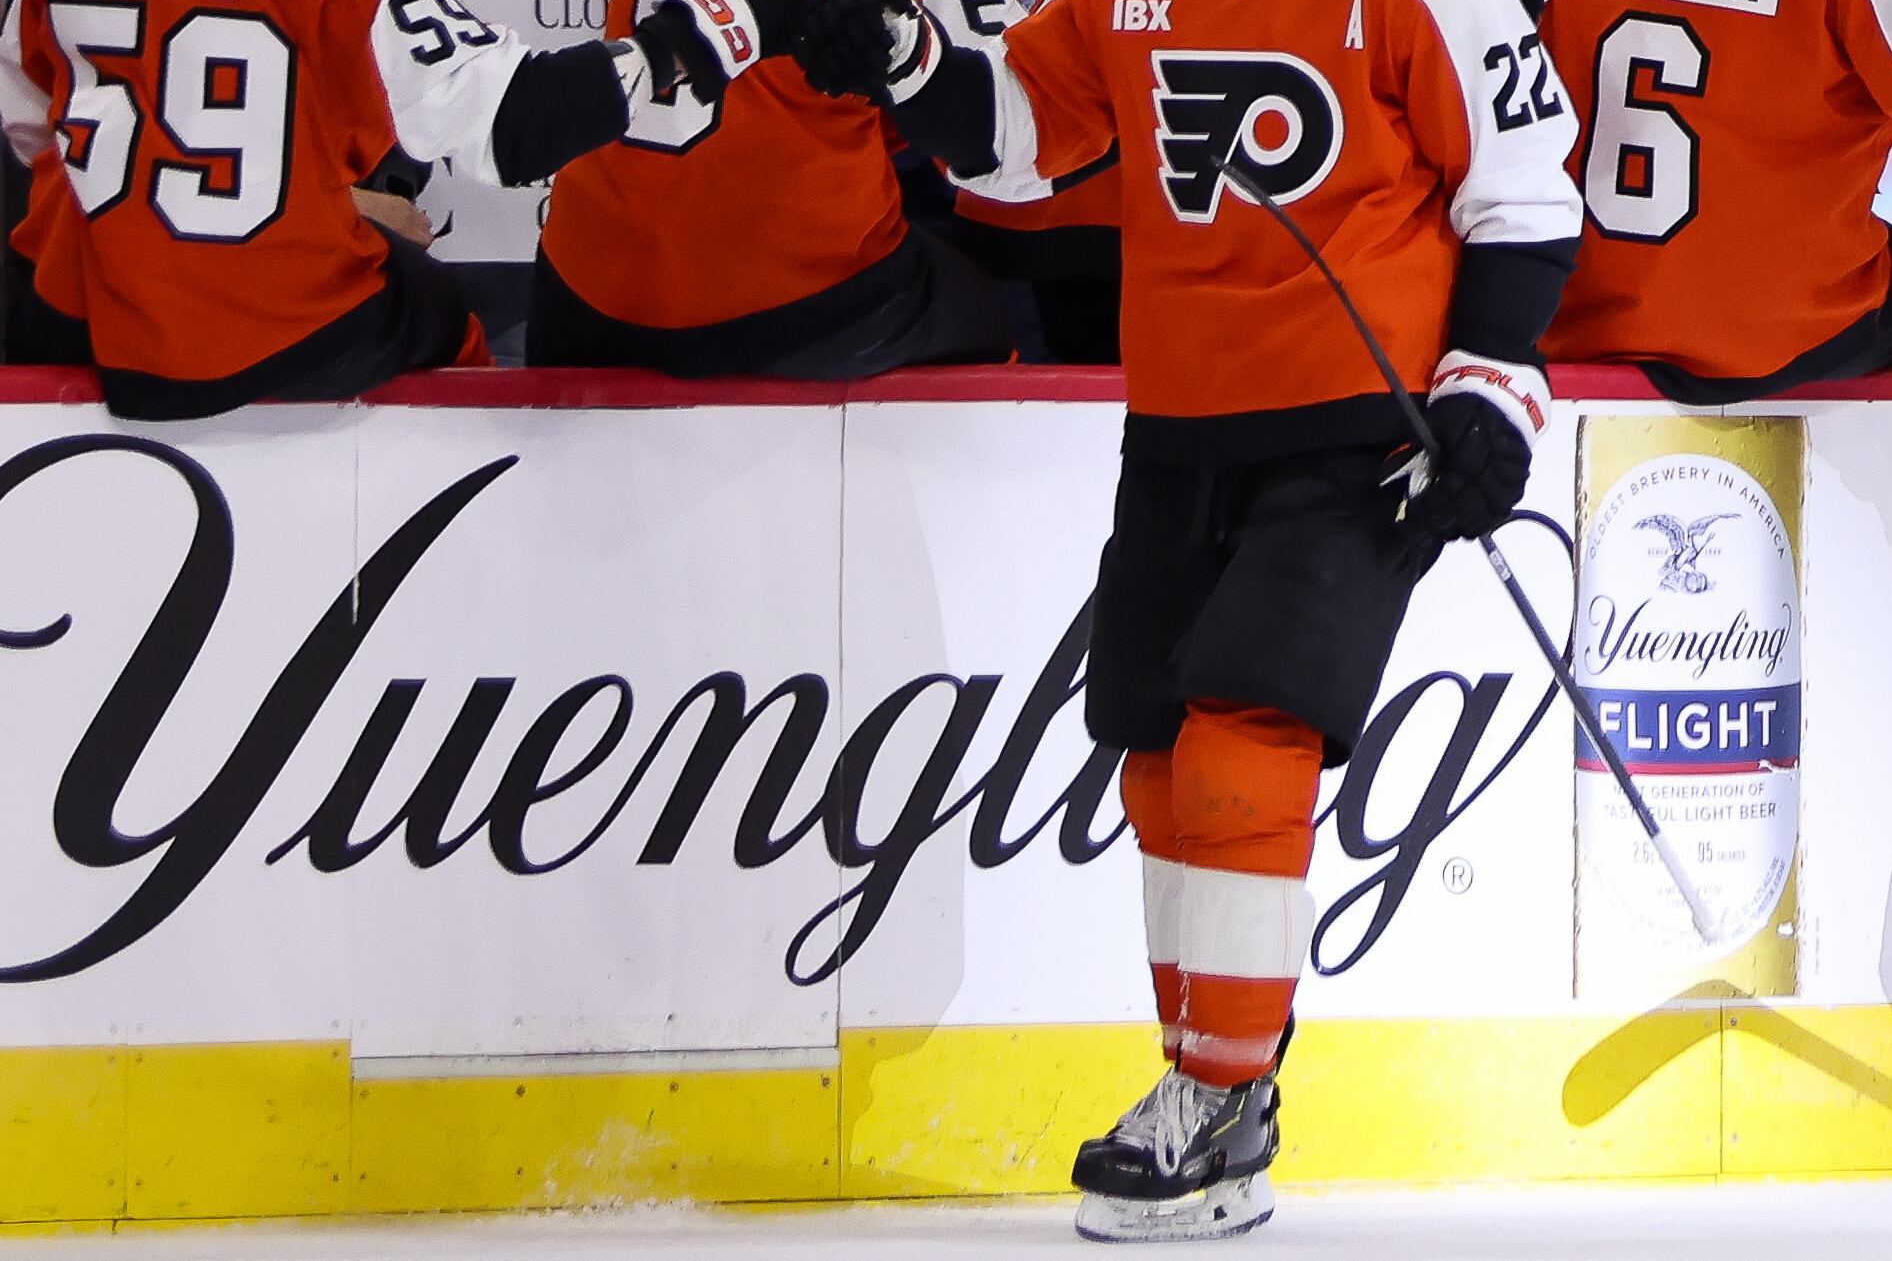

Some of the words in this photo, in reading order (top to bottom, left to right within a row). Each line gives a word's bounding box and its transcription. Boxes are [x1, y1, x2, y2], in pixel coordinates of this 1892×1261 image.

[1484, 32, 1565, 133] 22
[1583, 9, 1713, 246] 6
[1589, 493, 1625, 559] OLDEST
[1630, 466, 1710, 496] BREWERY
[1717, 471, 1735, 490] IN
[1739, 487, 1786, 560] AMERICA
[1584, 594, 1793, 680] Yuengling
[0, 433, 1576, 987] Yuenglig
[1598, 699, 1779, 752] FLIGHT
[1604, 803, 1680, 821] TASTFUL
[1685, 803, 1735, 822] LIGHT
[1740, 802, 1778, 820] BEER
[1613, 783, 1647, 797] NT
[1650, 783, 1745, 799] GENERATION
[1748, 782, 1767, 798] OF
[1697, 841, 1714, 864] 95
